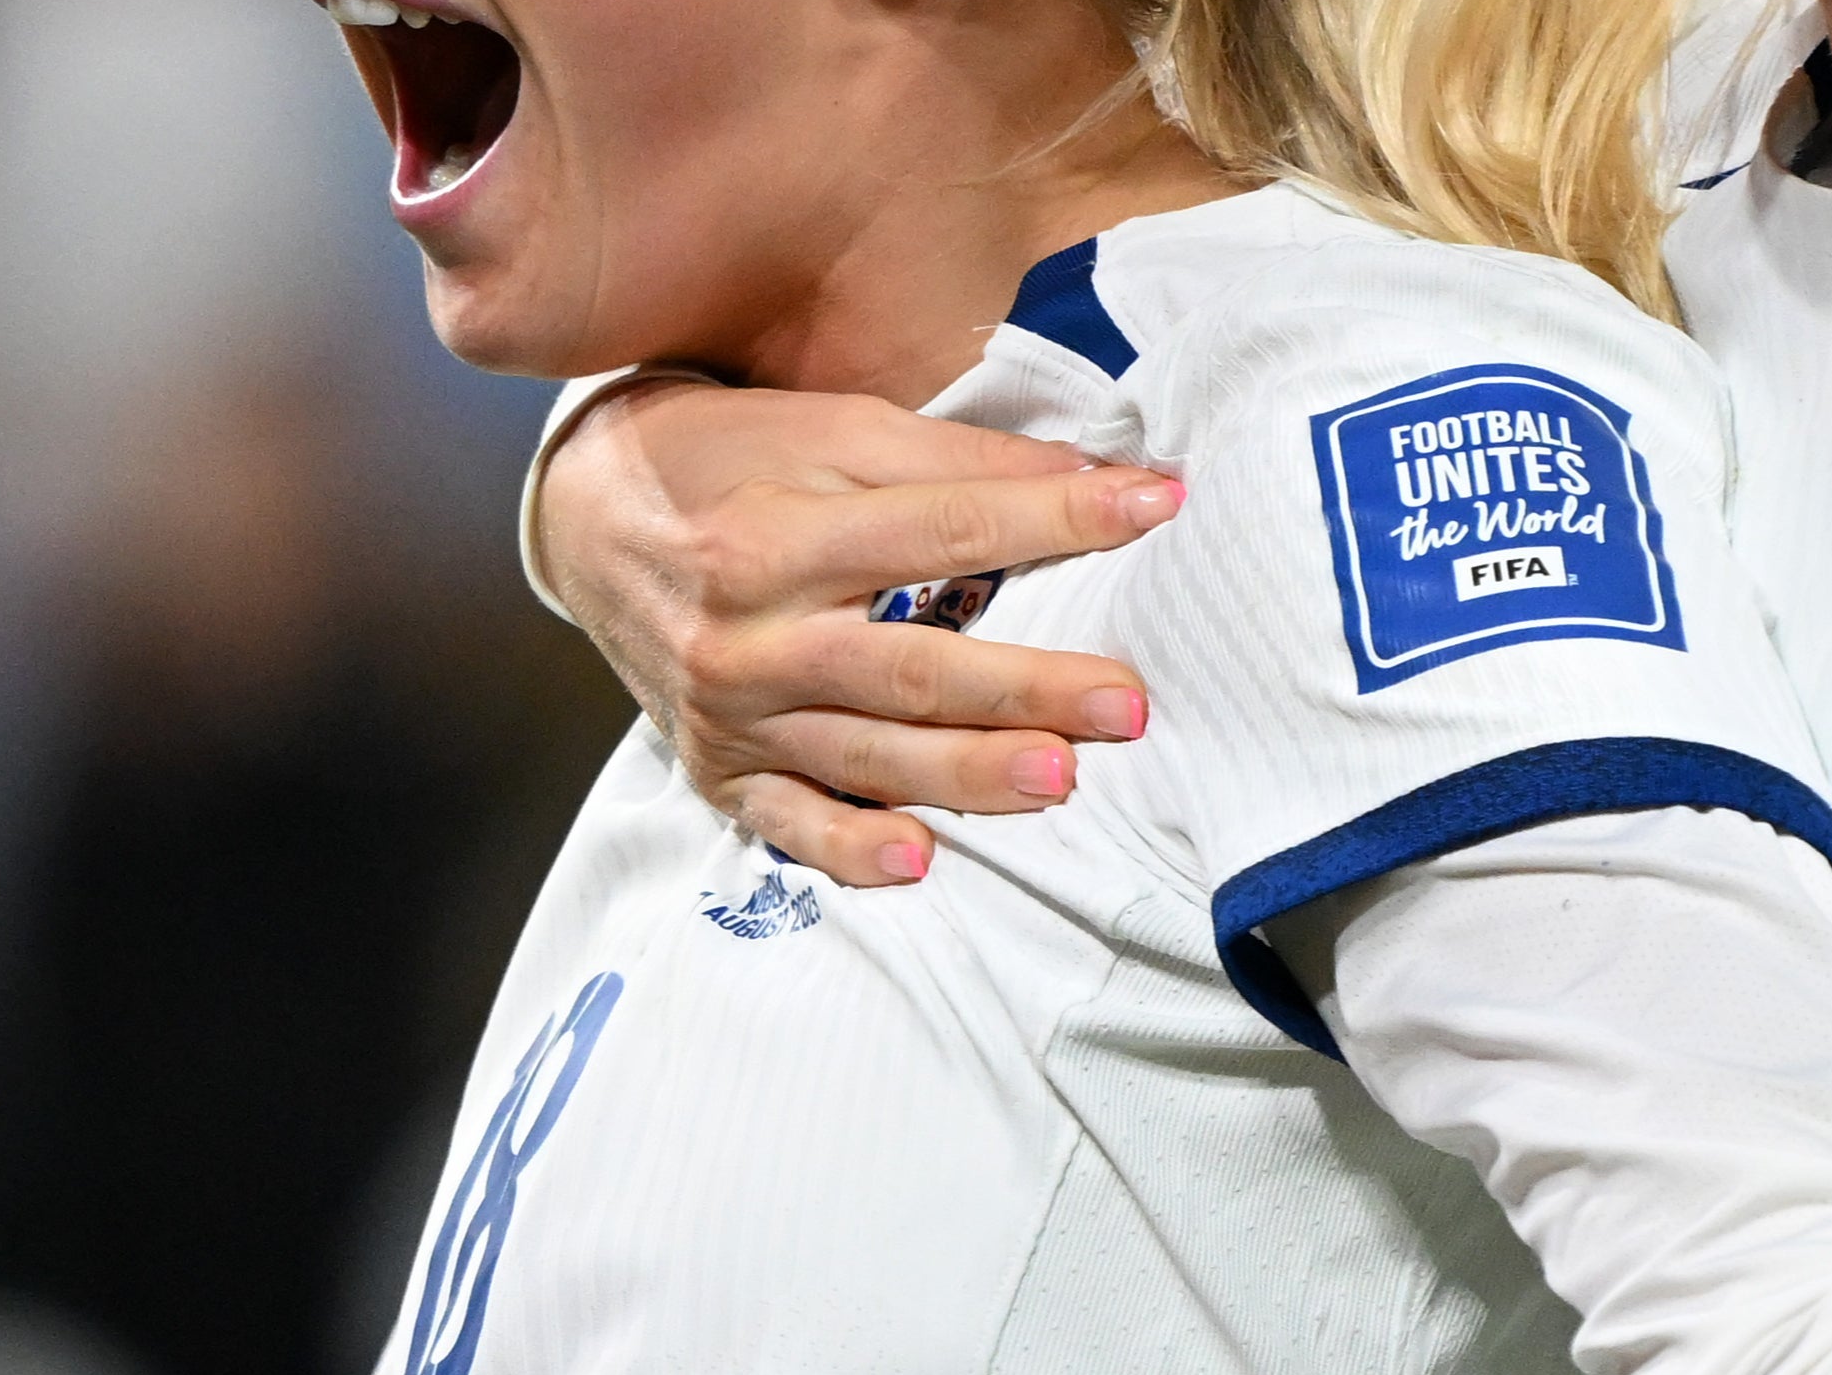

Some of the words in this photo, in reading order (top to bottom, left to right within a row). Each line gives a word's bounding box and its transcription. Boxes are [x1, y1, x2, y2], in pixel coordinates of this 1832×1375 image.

[1389, 410, 1583, 459] FOOTBALL
[1394, 446, 1591, 507] UNITES
[1389, 508, 1468, 561] the
[1473, 495, 1607, 544] World
[1470, 556, 1551, 586] FIFA
[701, 905, 789, 940] AUGUST
